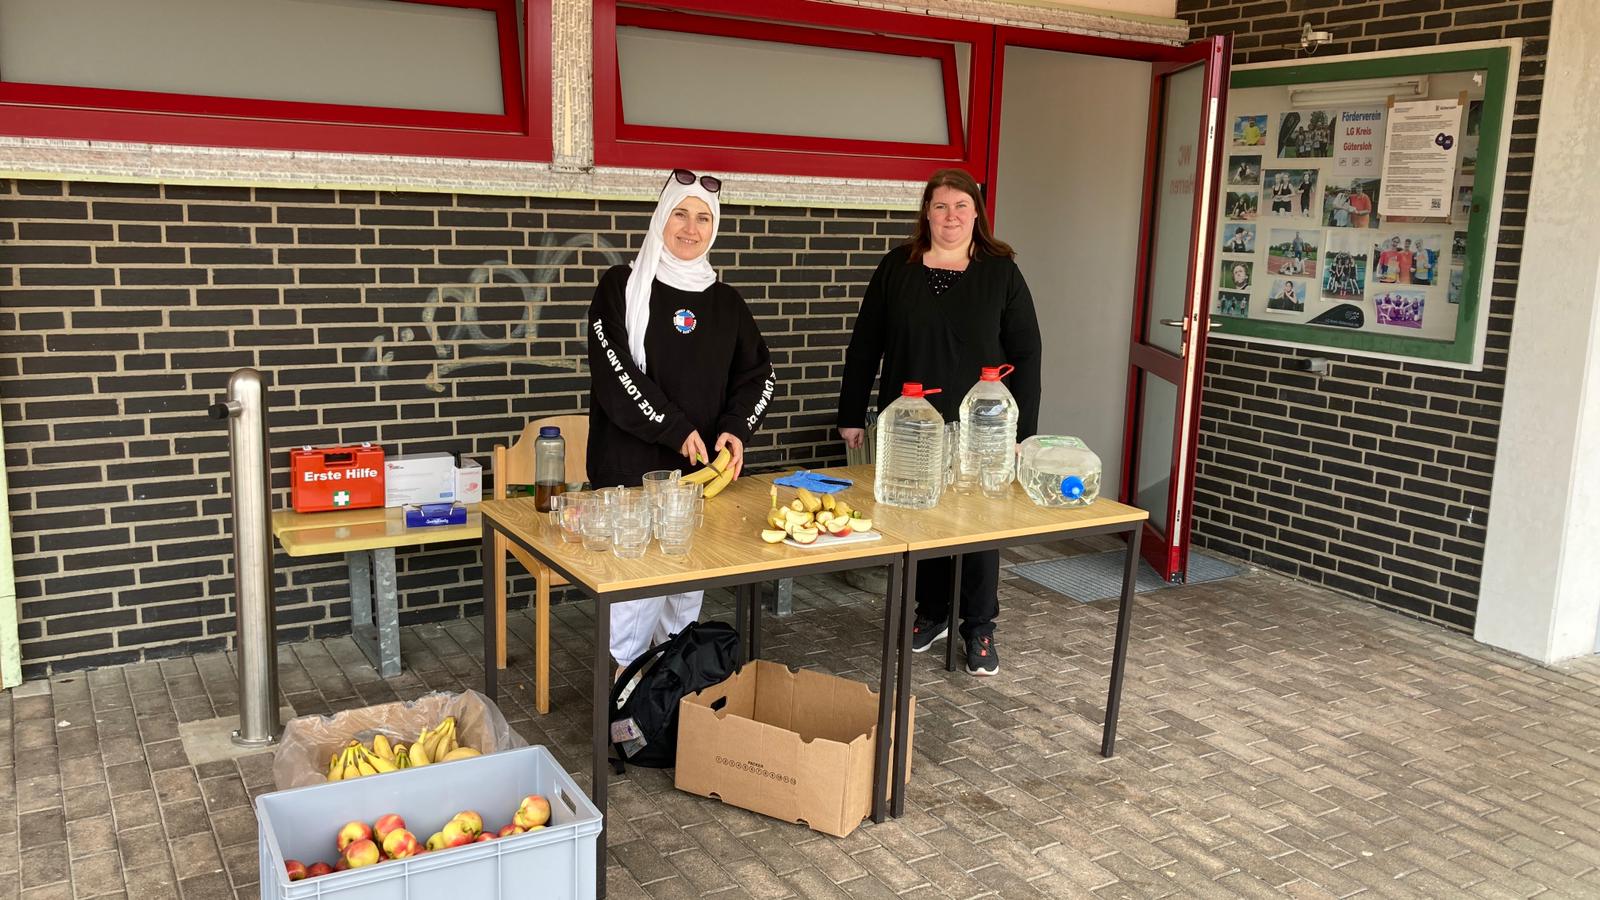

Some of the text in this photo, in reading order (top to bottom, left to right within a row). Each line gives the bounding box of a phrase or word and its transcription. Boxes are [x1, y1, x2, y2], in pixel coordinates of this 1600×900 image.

[1341, 109, 1381, 122] Förderverein
[1346, 126, 1372, 136] LG Kreis
[1343, 141, 1372, 151] Gütersloh
[593, 318, 609, 348] SOUL
[606, 348, 624, 372] AND
[618, 372, 642, 400] LOVE
[754, 396, 768, 416] AND
[304, 467, 378, 482] Erste Hilfe
